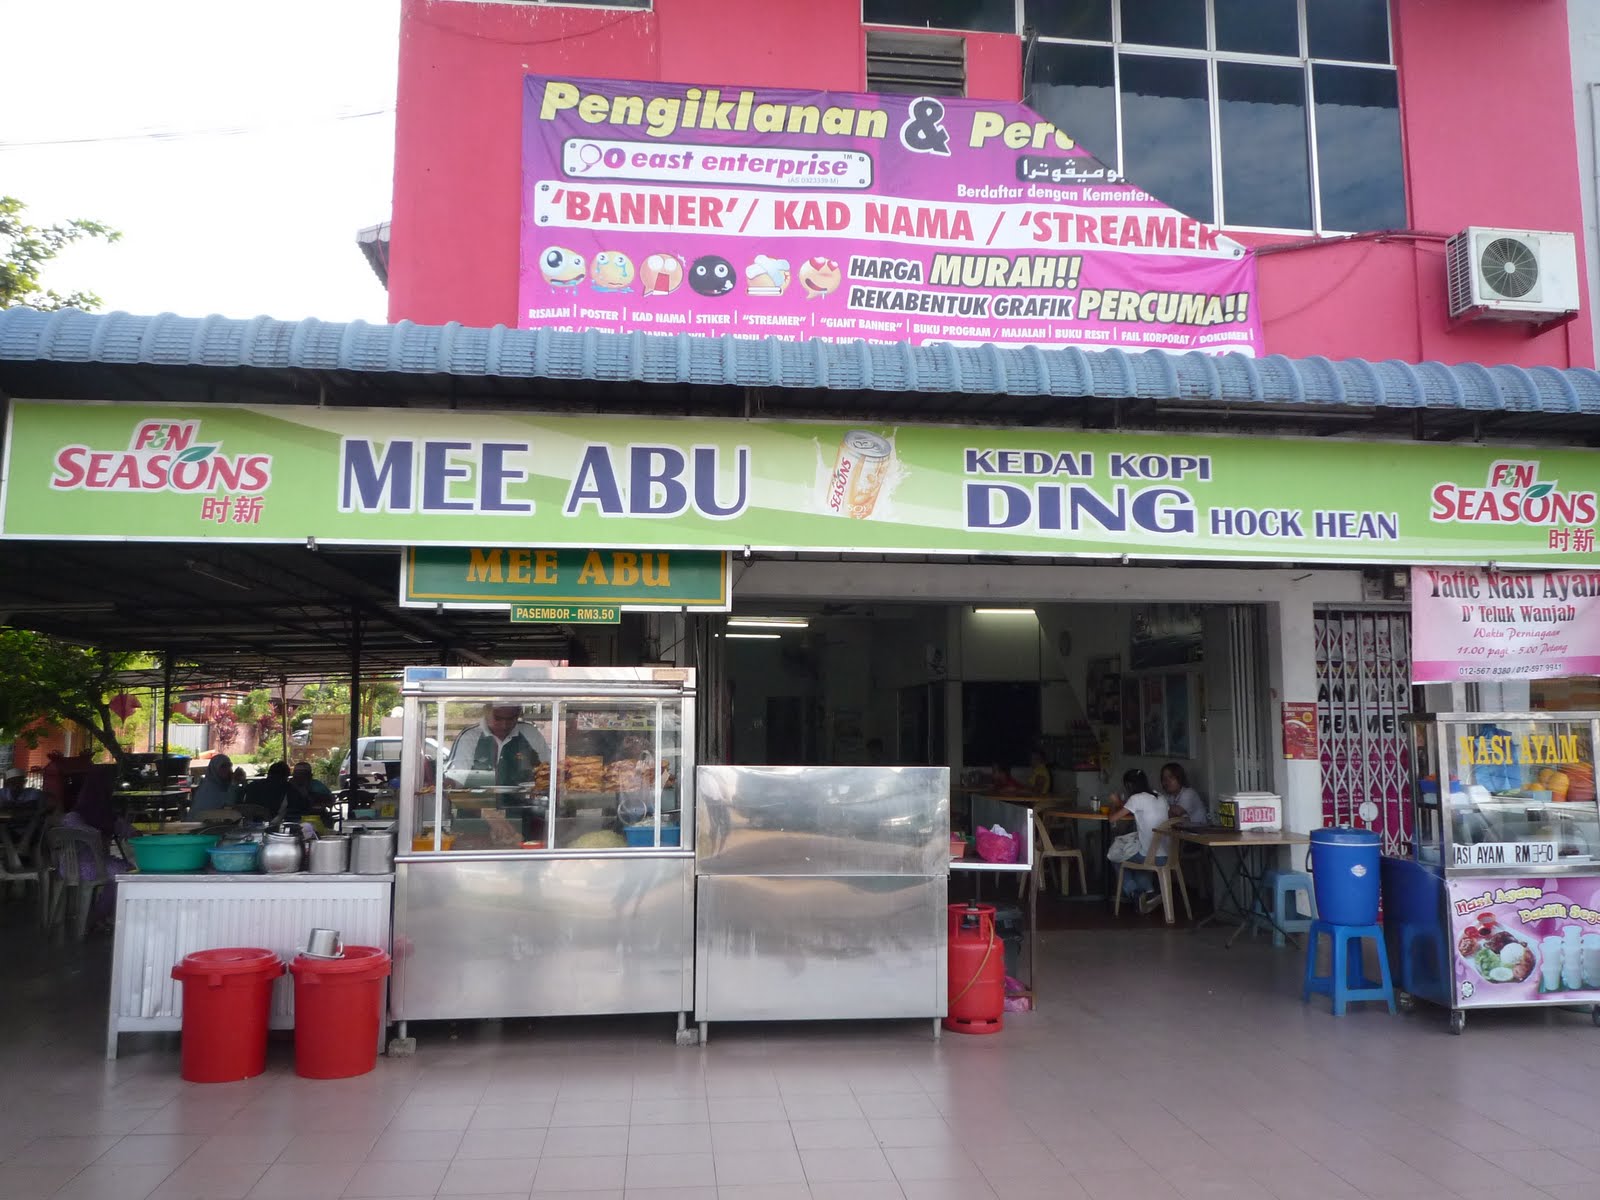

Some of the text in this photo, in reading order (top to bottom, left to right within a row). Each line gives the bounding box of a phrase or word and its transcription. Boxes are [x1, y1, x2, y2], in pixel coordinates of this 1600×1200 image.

[539, 80, 889, 139] Pengiklanan
[901, 97, 951, 156] &
[631, 151, 694, 170] east
[701, 153, 849, 178] enterprise
[957, 184, 1023, 199] Berdaftar
[1027, 183, 1078, 202] dengan
[773, 200, 850, 232] KAD
[864, 203, 975, 242] NAMA
[849, 255, 1082, 289] HARGA MURAH!!
[528, 308, 571, 320] RISALAH
[580, 308, 619, 321] POSTER
[632, 311, 686, 324] KAD NAMA
[695, 314, 731, 325] STIKER
[849, 289, 1249, 326] REKABENTUK GRAFIK PERCUMA!!
[913, 323, 940, 335] BUKU
[942, 325, 991, 338] PROGRAM
[1001, 328, 1046, 339] MAJALAH
[1054, 329, 1110, 341] BUKU RESIT
[1121, 331, 1141, 342] FAIL
[1143, 333, 1190, 345] KORPORAT
[1199, 331, 1248, 344] DOKUMEN
[135, 423, 194, 451] F&N
[53, 447, 269, 490] SEASONS
[341, 438, 748, 518] MEE ABU
[965, 450, 1210, 480] KEDAI KOPI
[1491, 464, 1534, 488] F&N
[201, 495, 265, 524] 时新
[966, 483, 1398, 540] DING HOCK HEAN
[1432, 484, 1596, 524] SEASONS
[1549, 528, 1595, 553] 时新
[465, 549, 671, 588] MEE ABU
[1427, 569, 1481, 599] Yatie
[516, 608, 570, 619] PASEMBOR
[1478, 605, 1516, 623] Teluk
[1519, 604, 1576, 624] Wanjah
[1487, 647, 1508, 658] pagi
[1459, 734, 1580, 765] NASI AYAM
[1477, 846, 1505, 864] AYAM
[1455, 891, 1494, 916] Nasi
